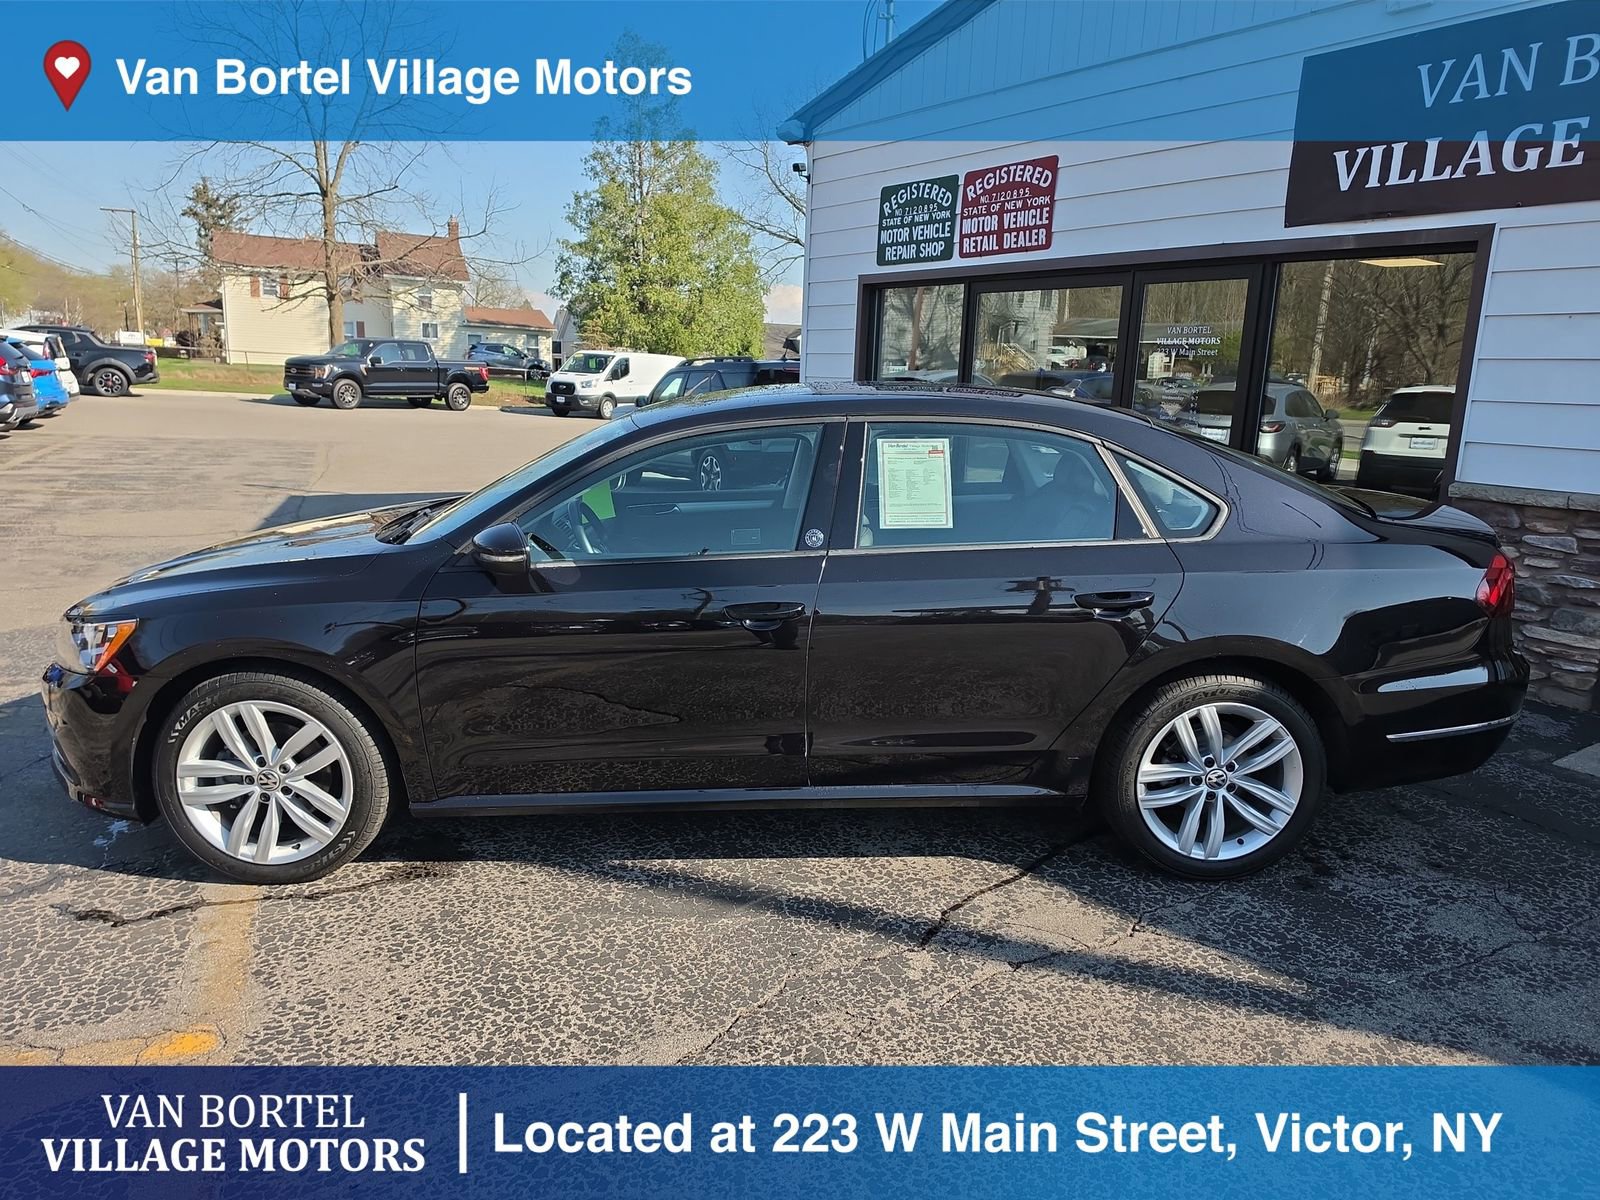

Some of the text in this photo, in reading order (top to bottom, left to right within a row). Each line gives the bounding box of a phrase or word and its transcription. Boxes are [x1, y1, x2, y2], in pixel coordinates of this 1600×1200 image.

[1417, 41, 1543, 109] VAN
[1333, 116, 1591, 192] VILLAGE
[966, 164, 1053, 202] REGISTERED
[883, 183, 953, 216] REGISTERED
[991, 188, 1032, 202] 7120895
[905, 203, 939, 215] 7120895
[963, 196, 1052, 217] STATE OF NEW YORK
[882, 210, 951, 227] STATE OF NEW YORK
[962, 207, 1050, 235] MOTOR VEHICLE
[880, 222, 951, 245] MOTOR VEHICLE
[963, 228, 1047, 254] RETAIL DEALER
[885, 241, 945, 261] REPAIR SHOP
[1156, 337, 1221, 345] VILLAGE MOTORS
[1167, 326, 1212, 334] VAN BORTEL
